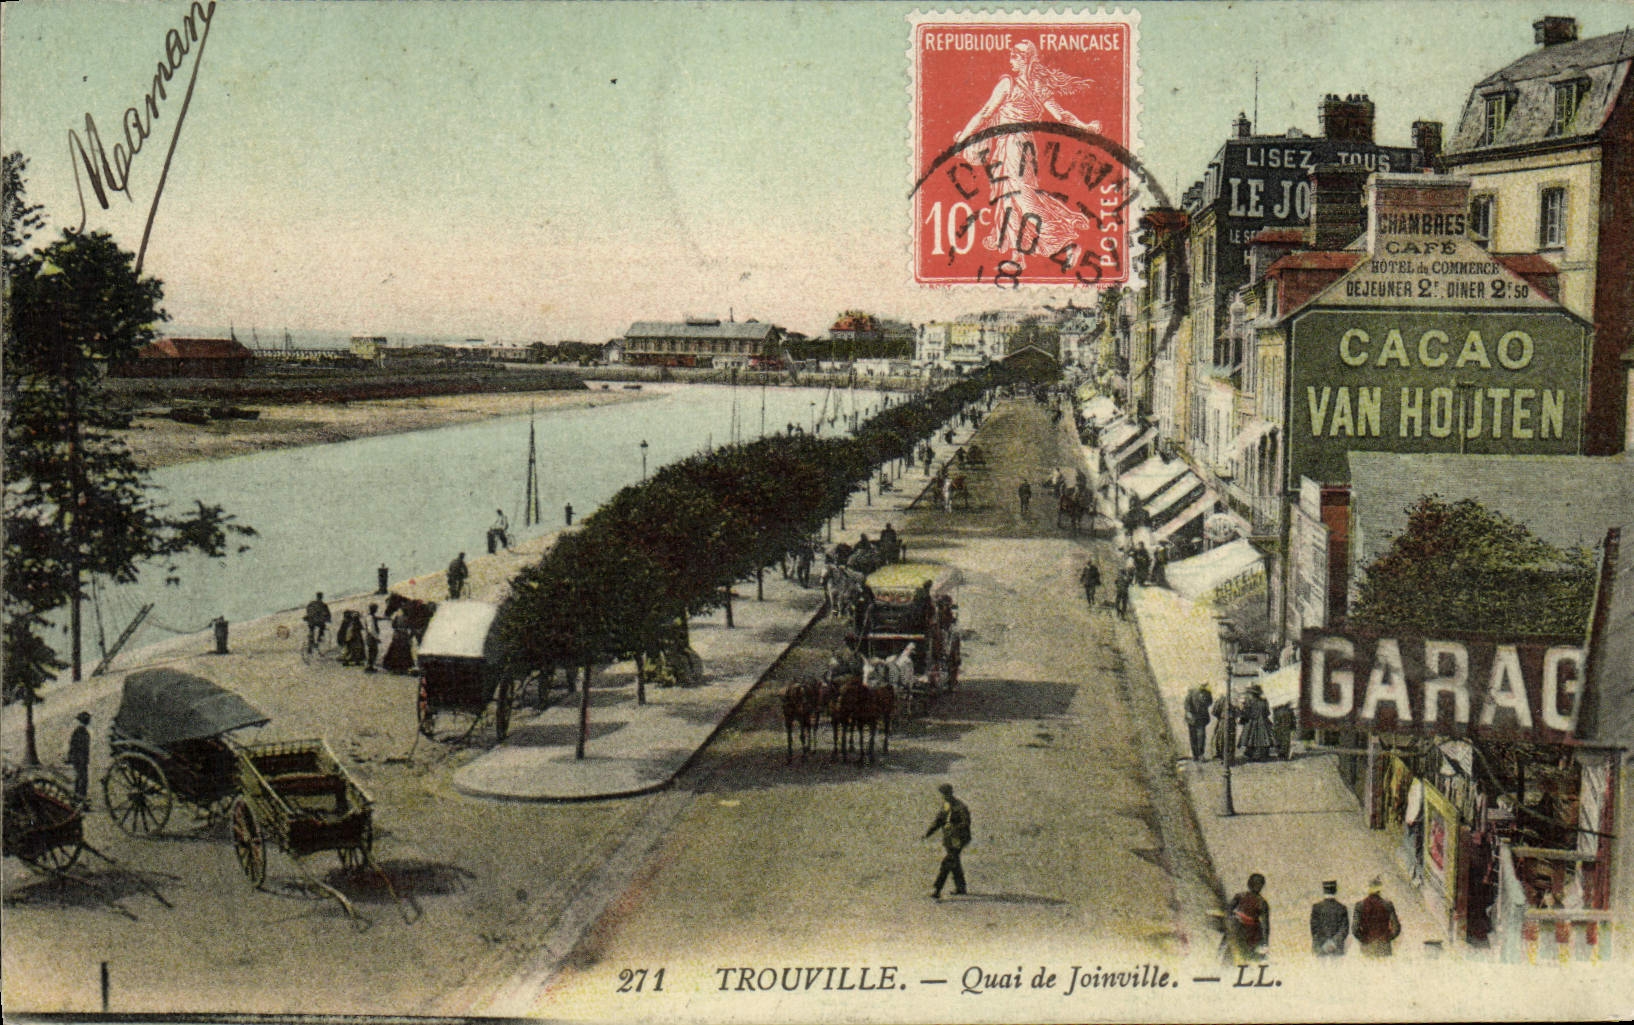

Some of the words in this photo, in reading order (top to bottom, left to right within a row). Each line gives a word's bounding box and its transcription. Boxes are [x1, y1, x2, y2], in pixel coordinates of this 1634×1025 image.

[925, 33, 1012, 51] REPUBLIQUE
[1039, 33, 1120, 52] FRANÇAISE
[1246, 146, 1312, 169] LISEZ
[1228, 177, 1265, 218] LE
[1099, 183, 1118, 267] POSTES
[1378, 212, 1466, 235] CHAMBRES
[1431, 261, 1500, 275] COMMERCE
[1338, 327, 1535, 370] CACAO
[1306, 385, 1382, 438] VAN
[1401, 386, 1566, 440] HOUTEN
